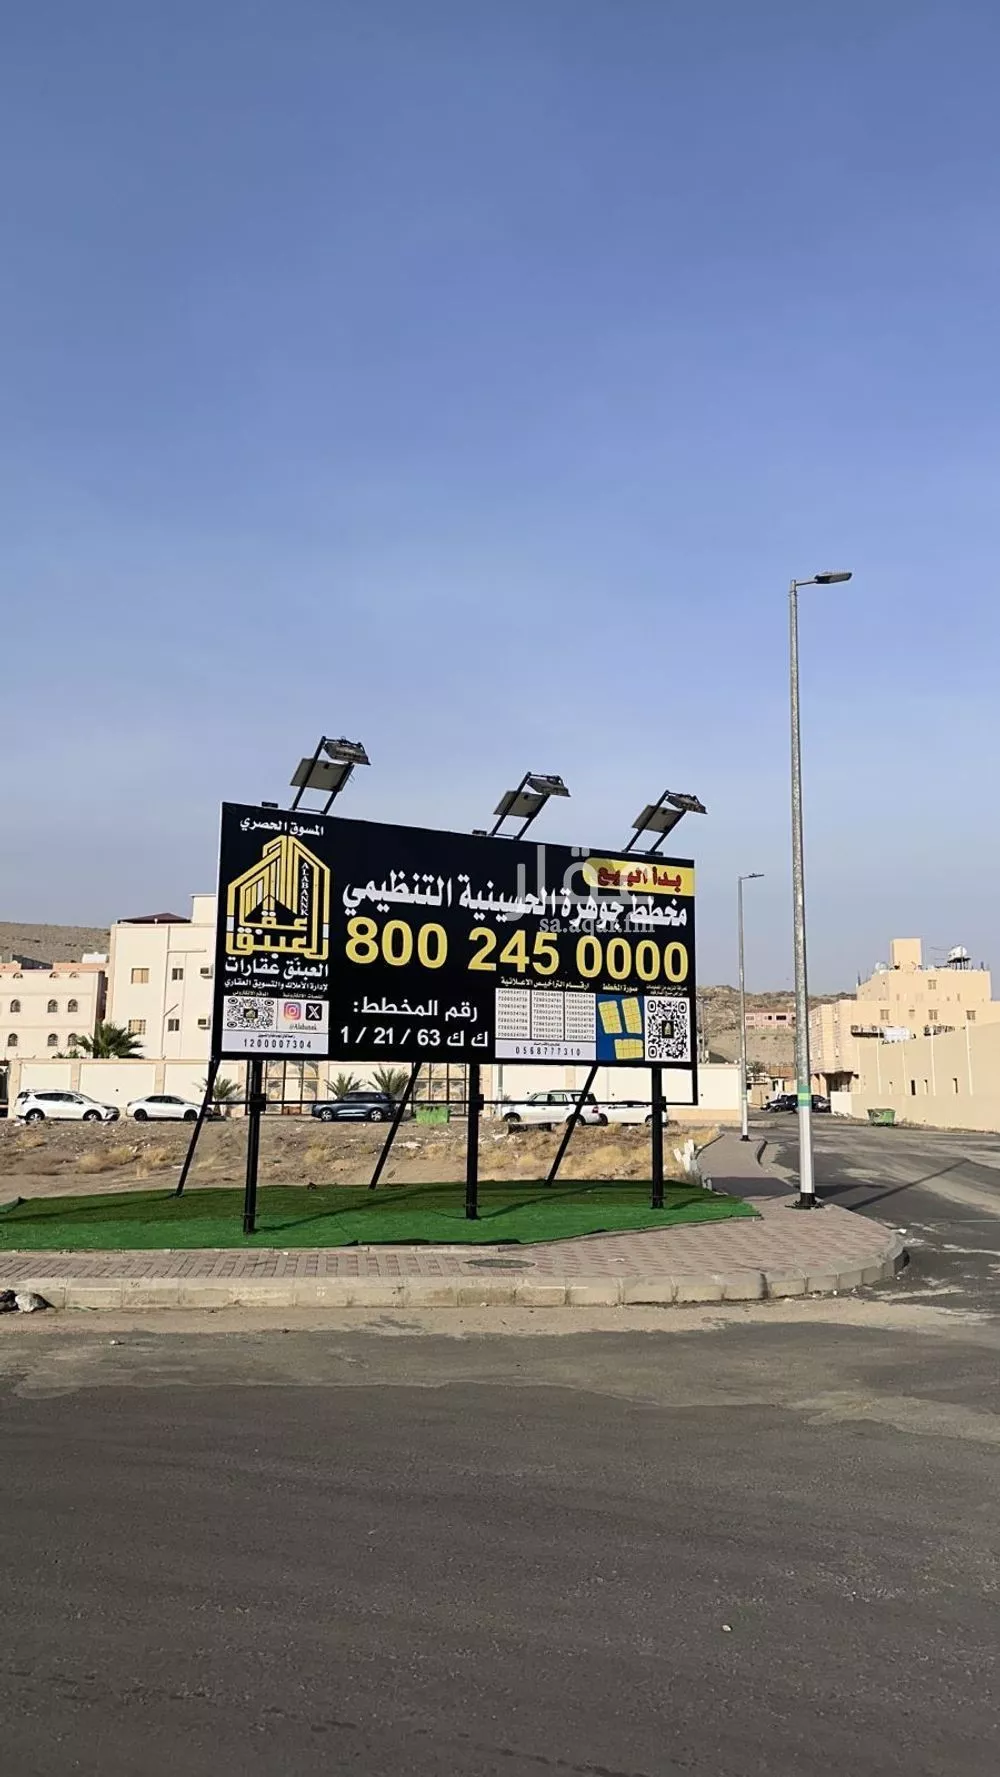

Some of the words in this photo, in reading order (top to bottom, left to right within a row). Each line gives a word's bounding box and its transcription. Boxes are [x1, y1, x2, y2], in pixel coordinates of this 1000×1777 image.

[240, 817, 288, 831] الحصري
[289, 821, 324, 836] المسوق
[342, 869, 453, 916] التنظيمي
[457, 874, 556, 923] الحسينية
[560, 888, 624, 930] جوهرة
[629, 894, 687, 926] مخطط
[345, 916, 448, 969] 800
[467, 926, 560, 976] 245
[576, 934, 689, 983] 0000
[225, 956, 280, 976] عقارات
[224, 977, 251, 988] العقاري
[353, 996, 439, 1017] المخطط:
[445, 1001, 478, 1023] رقم
[340, 1025, 349, 1044] 1
[355, 1026, 367, 1044] /
[373, 1027, 394, 1045] 21
[400, 1027, 412, 1046] /
[417, 1028, 441, 1047] 63
[446, 1030, 465, 1047] ك
[470, 1031, 489, 1048] ك
